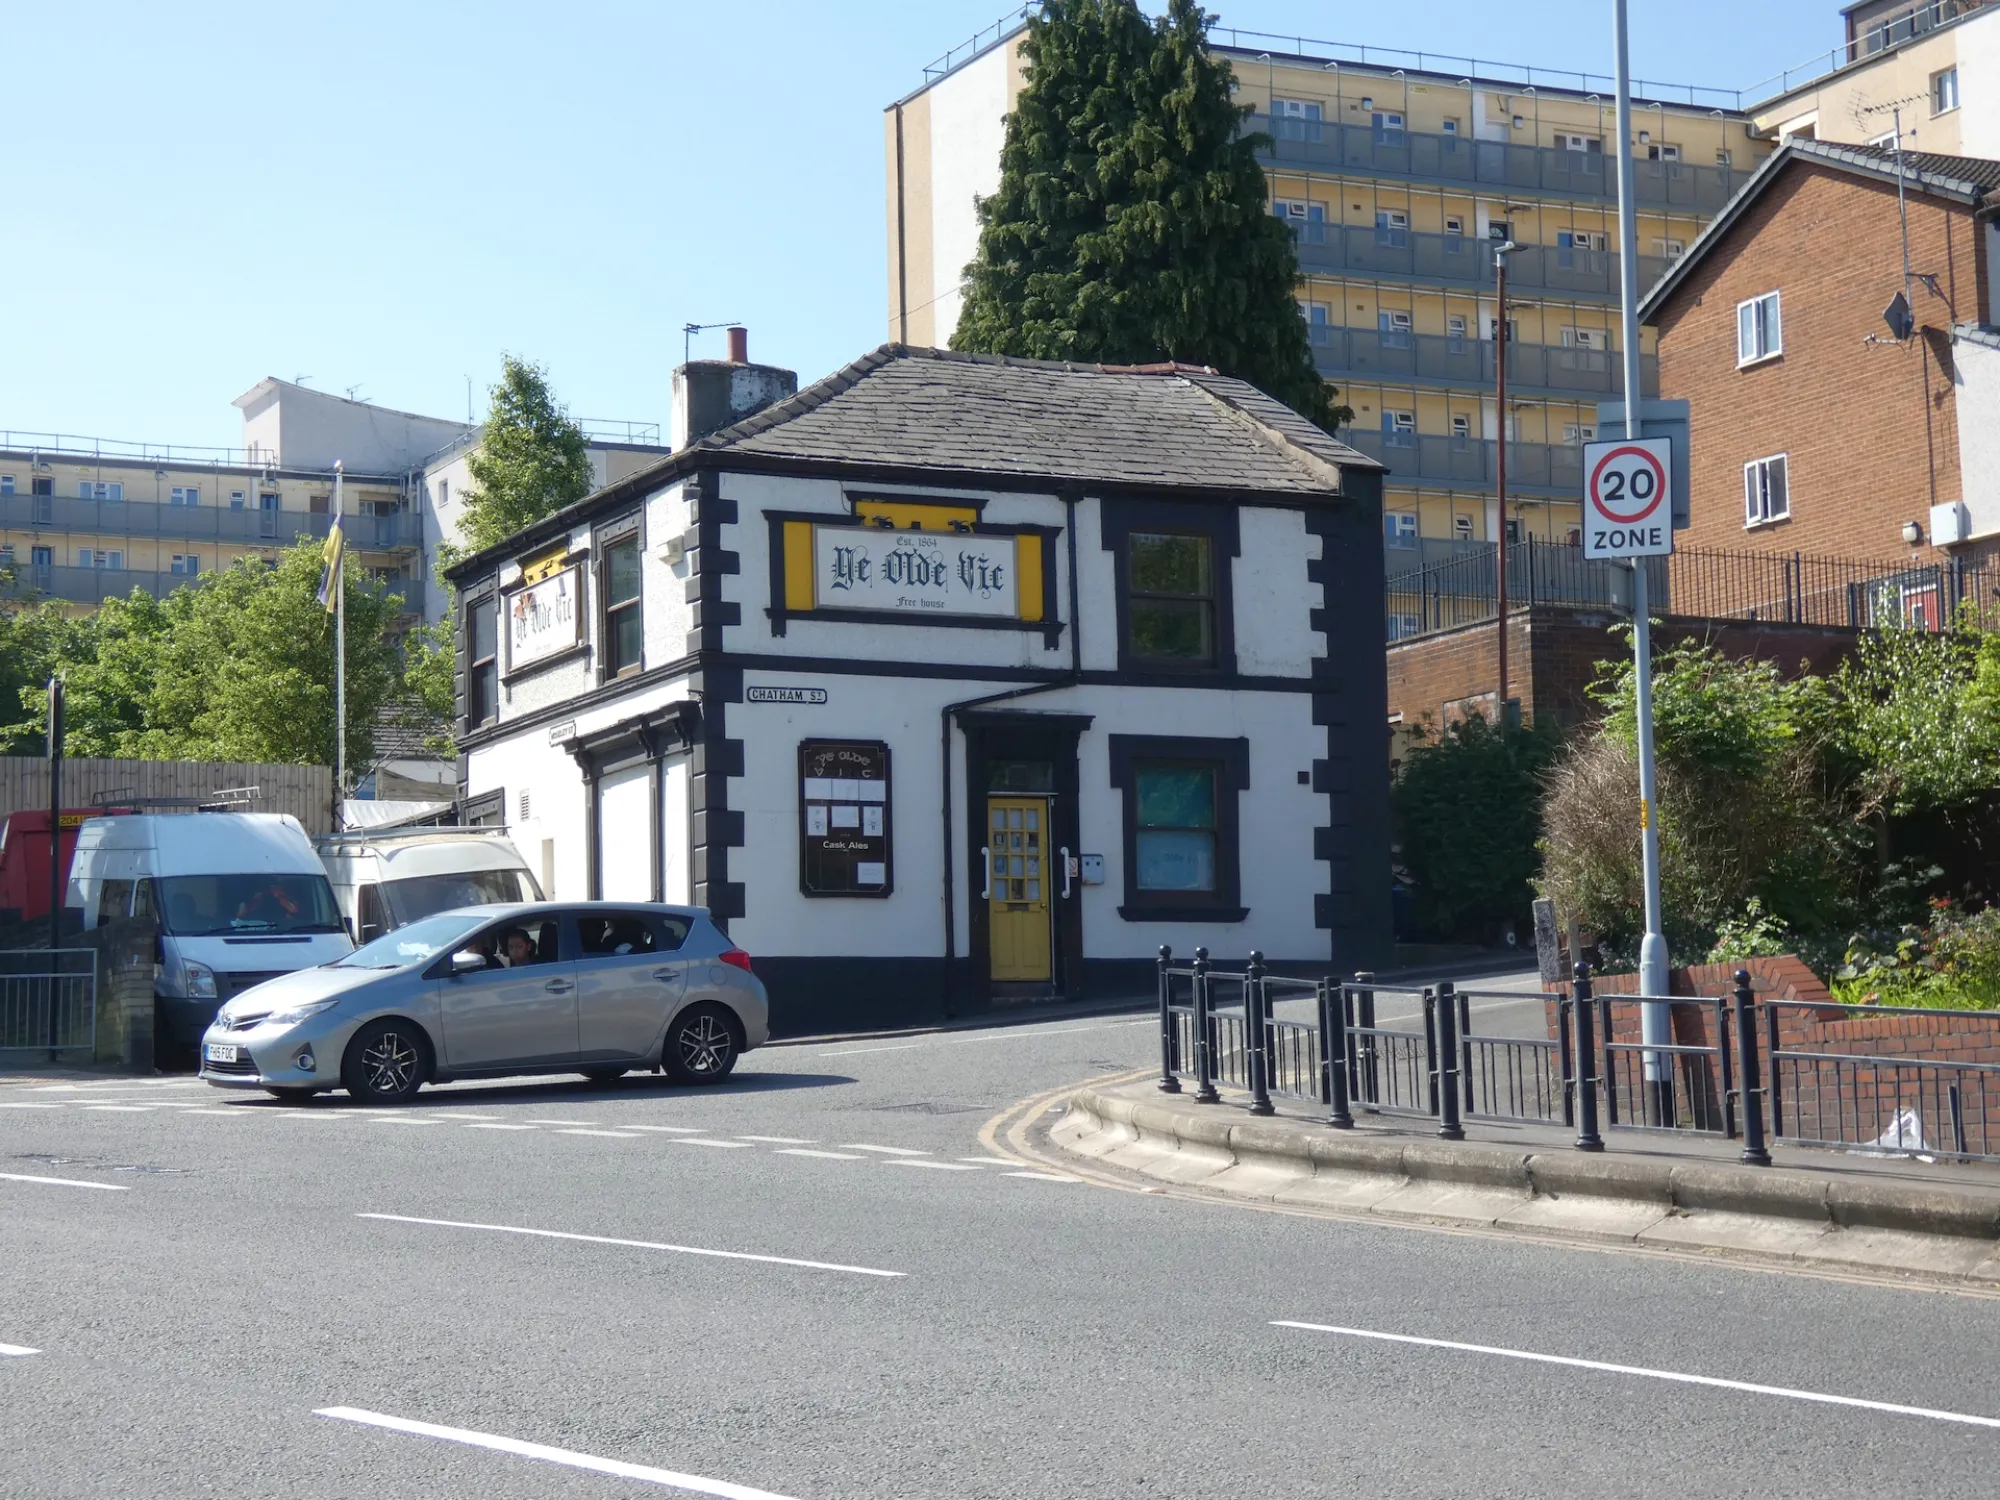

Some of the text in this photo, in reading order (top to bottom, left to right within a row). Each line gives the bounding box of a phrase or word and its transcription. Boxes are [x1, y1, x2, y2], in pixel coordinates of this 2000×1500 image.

[1603, 469, 1654, 501] 20
[918, 537, 938, 548] 1864
[1594, 527, 1662, 550] ZONE
[830, 545, 1005, 600] Ye Olde Vic
[896, 596, 945, 609] Free house
[752, 689, 803, 701] CHATHAM
[823, 840, 869, 850] Cask Ales
